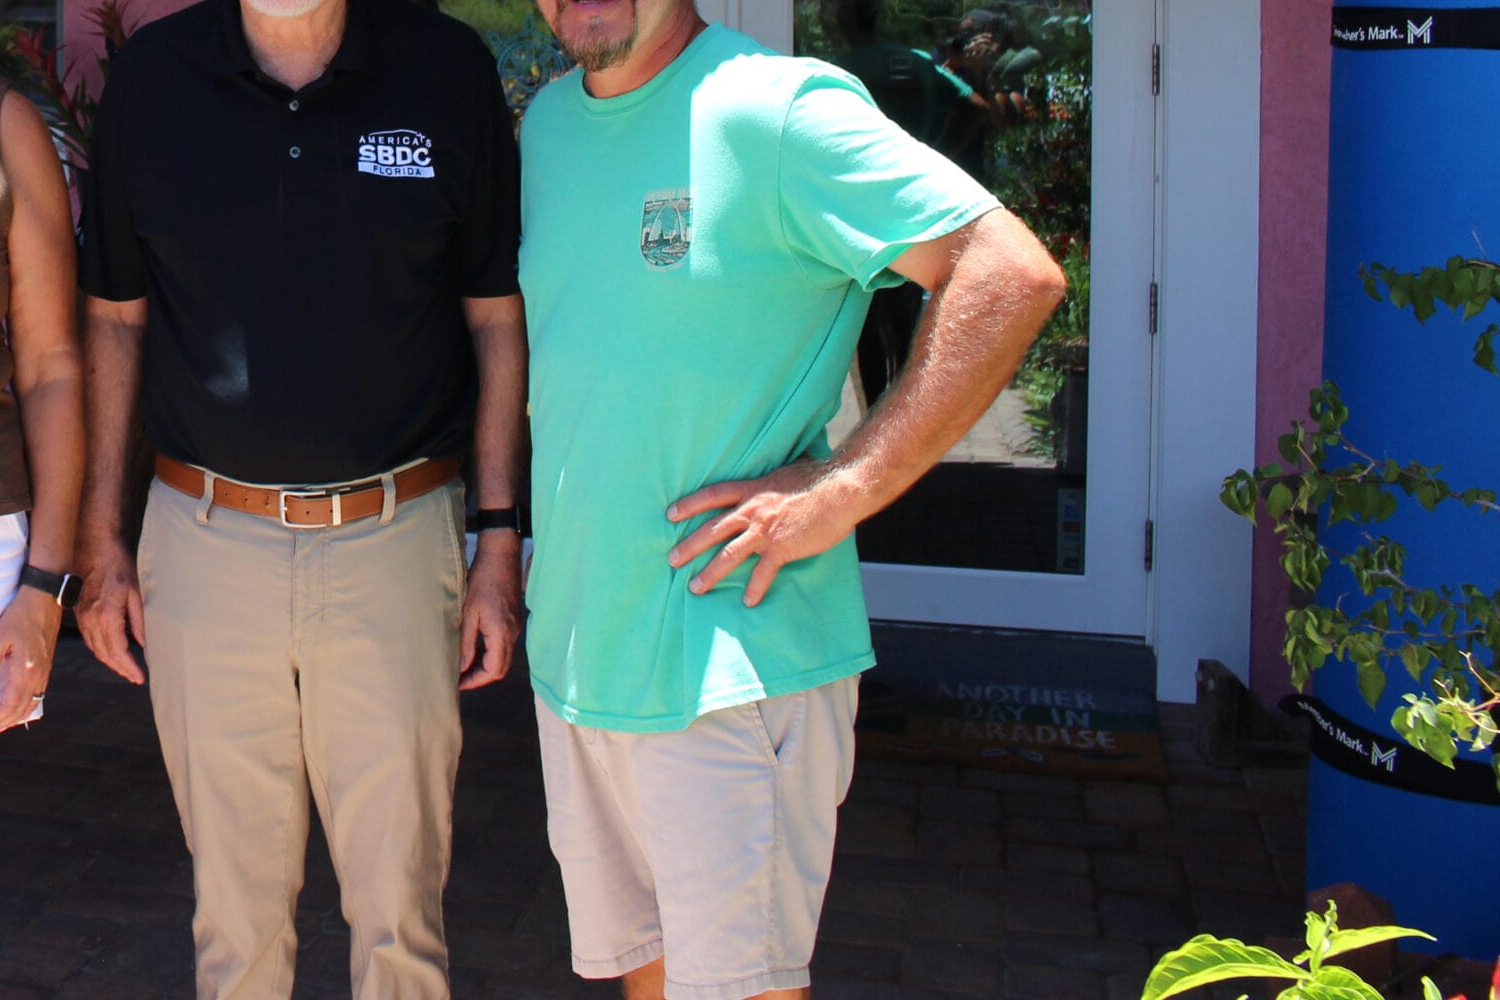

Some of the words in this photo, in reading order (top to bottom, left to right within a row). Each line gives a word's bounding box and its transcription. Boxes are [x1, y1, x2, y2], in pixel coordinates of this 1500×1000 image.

[358, 144, 432, 166] SBDC
[373, 165, 422, 176] FLORIDA
[935, 681, 1097, 710] ANOTHER
[964, 702, 1026, 722] DAY
[1049, 707, 1091, 728] IN
[940, 718, 1117, 750] PARADISE
